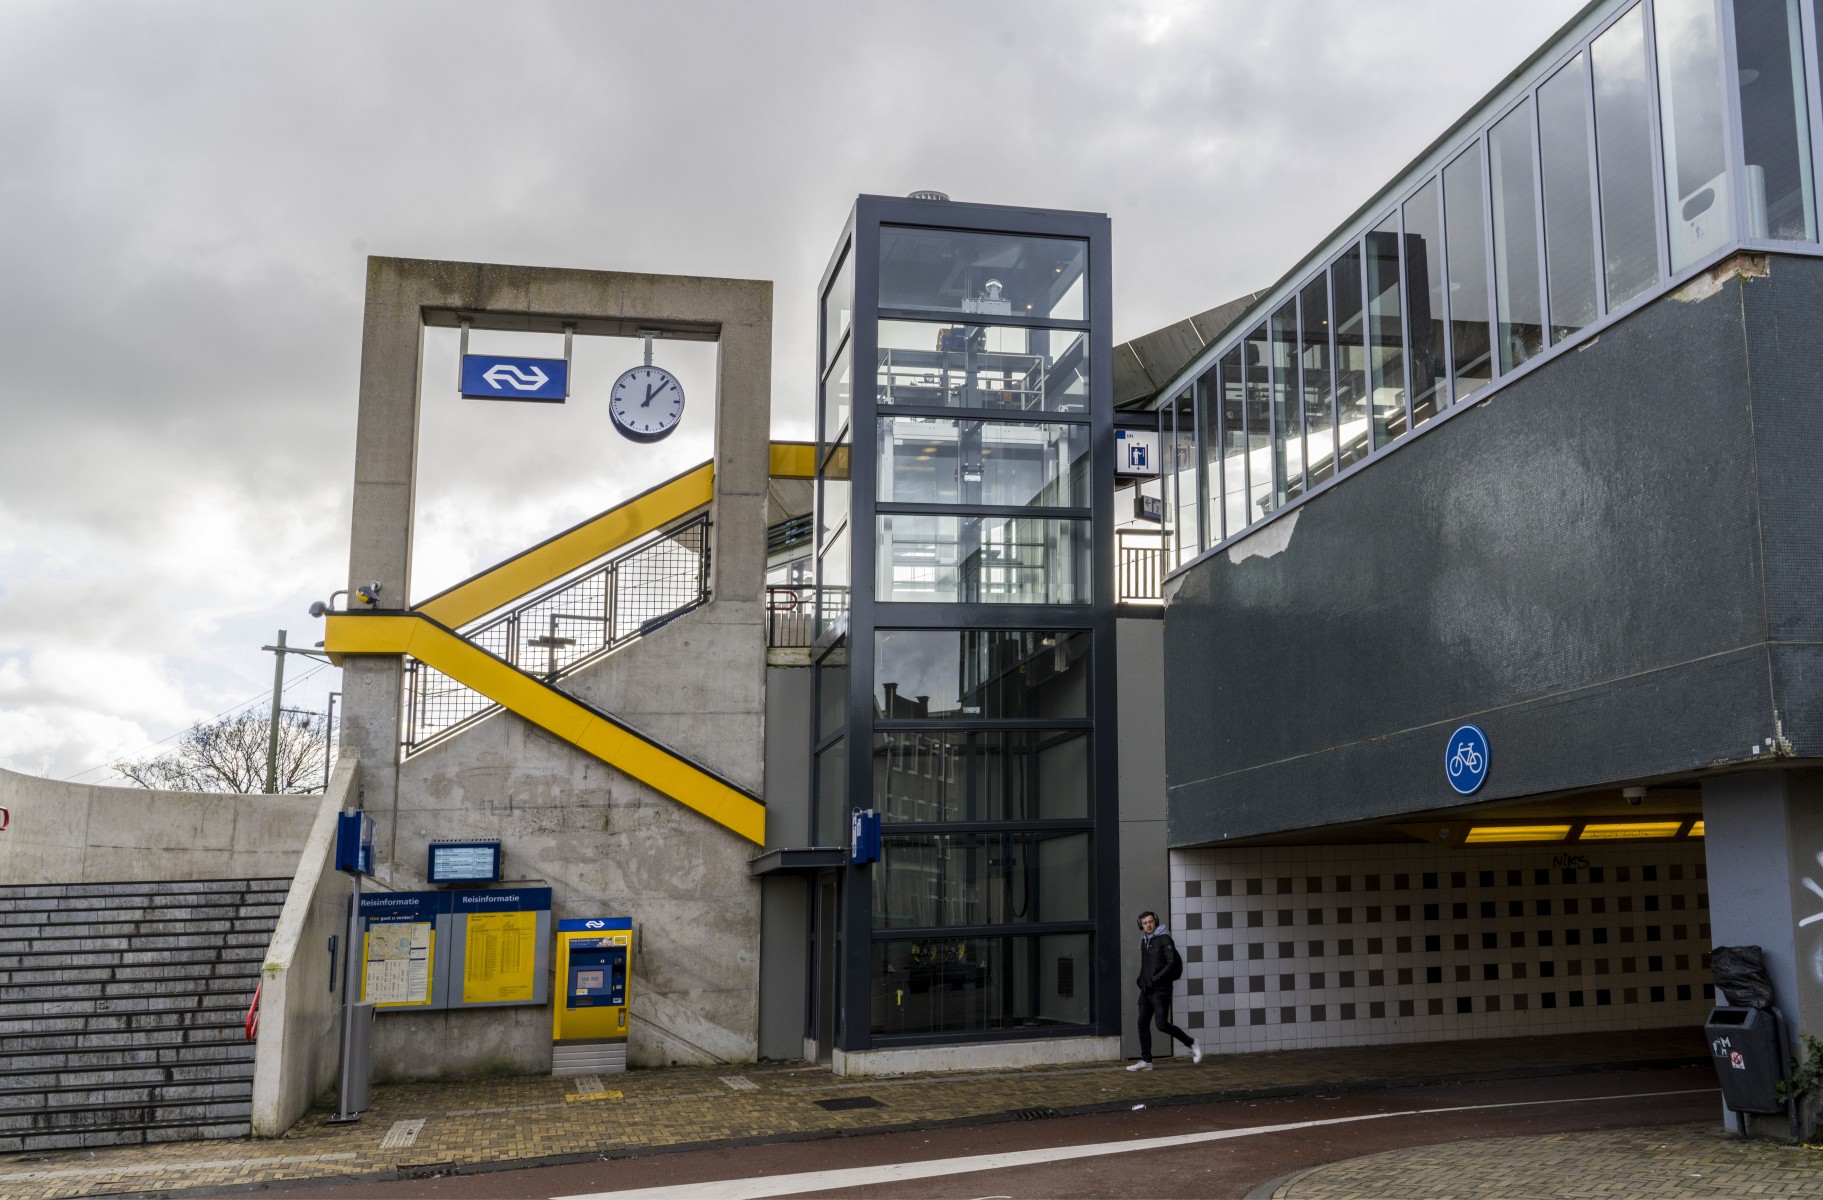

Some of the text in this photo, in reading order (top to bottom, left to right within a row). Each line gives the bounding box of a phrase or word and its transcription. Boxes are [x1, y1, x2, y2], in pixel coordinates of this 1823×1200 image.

[1155, 505, 1160, 513] 2
[360, 898, 420, 906] Reisinformatie
[462, 895, 520, 903] Reisinformatie
